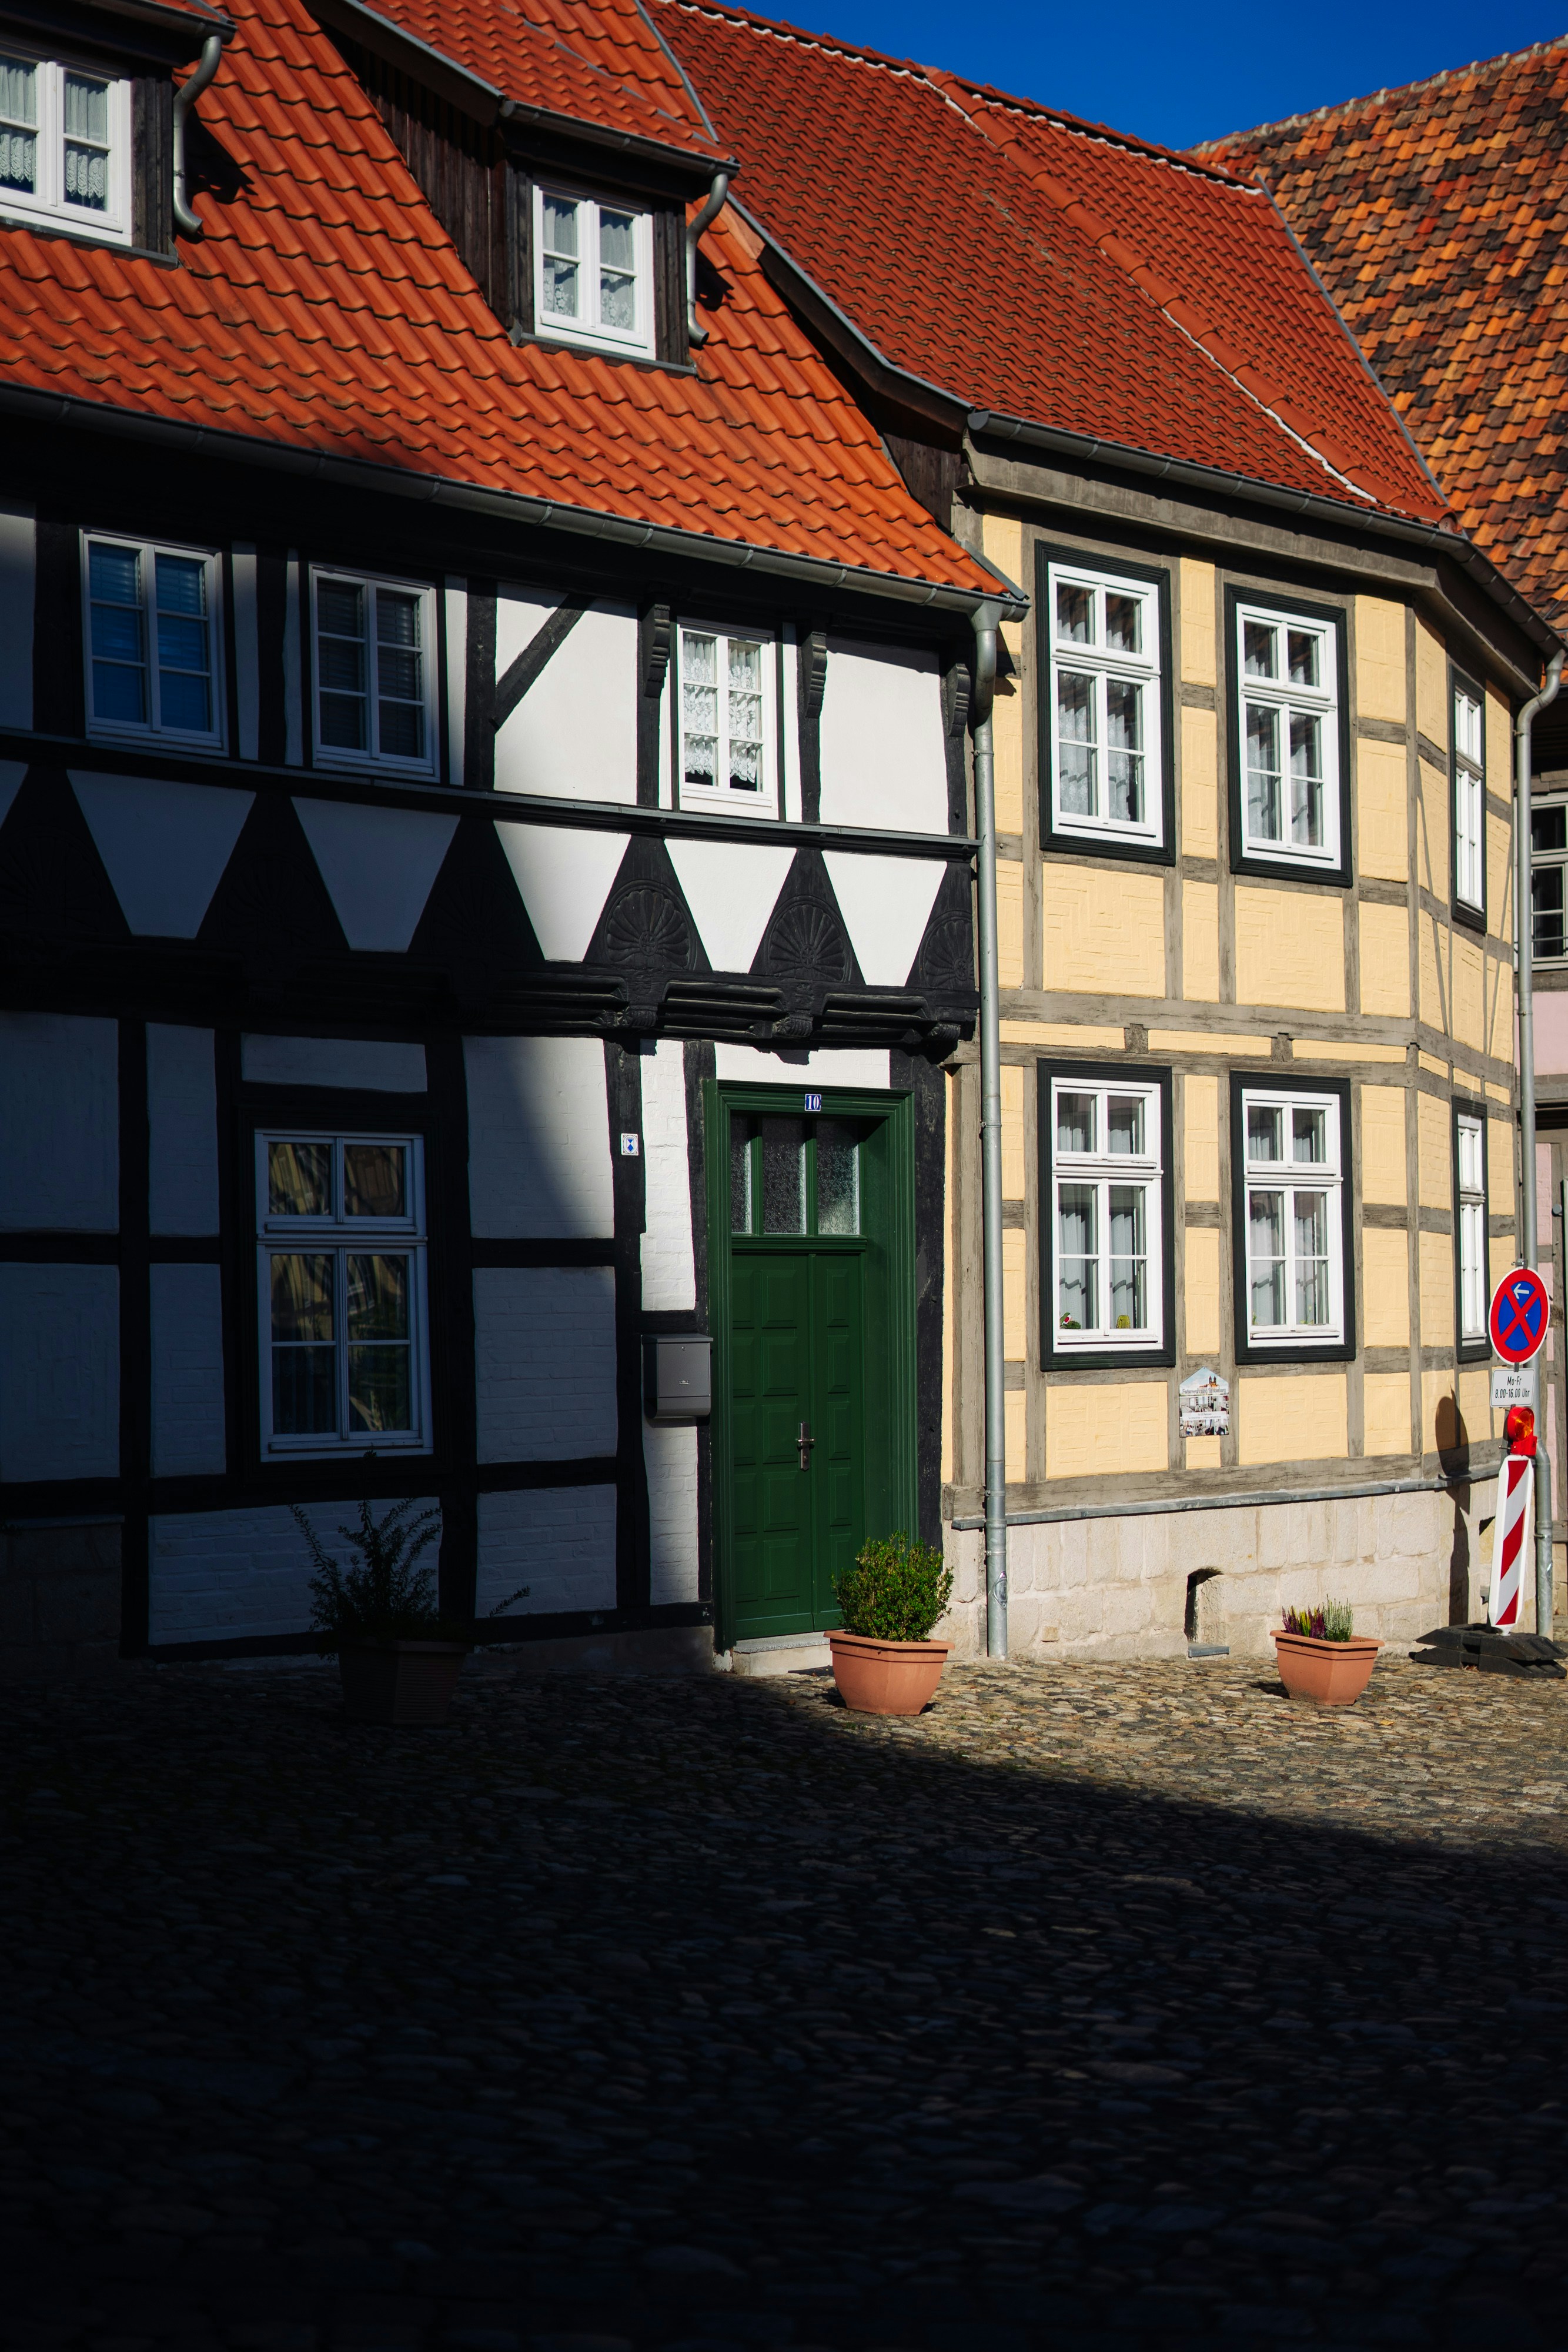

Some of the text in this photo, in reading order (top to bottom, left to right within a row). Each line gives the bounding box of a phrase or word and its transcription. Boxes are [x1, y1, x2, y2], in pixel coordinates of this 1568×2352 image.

[807, 1095, 820, 1110] 10
[1507, 1376, 1522, 1385] Mo-Fr
[1495, 1388, 1520, 1398] 8.00-16.00
